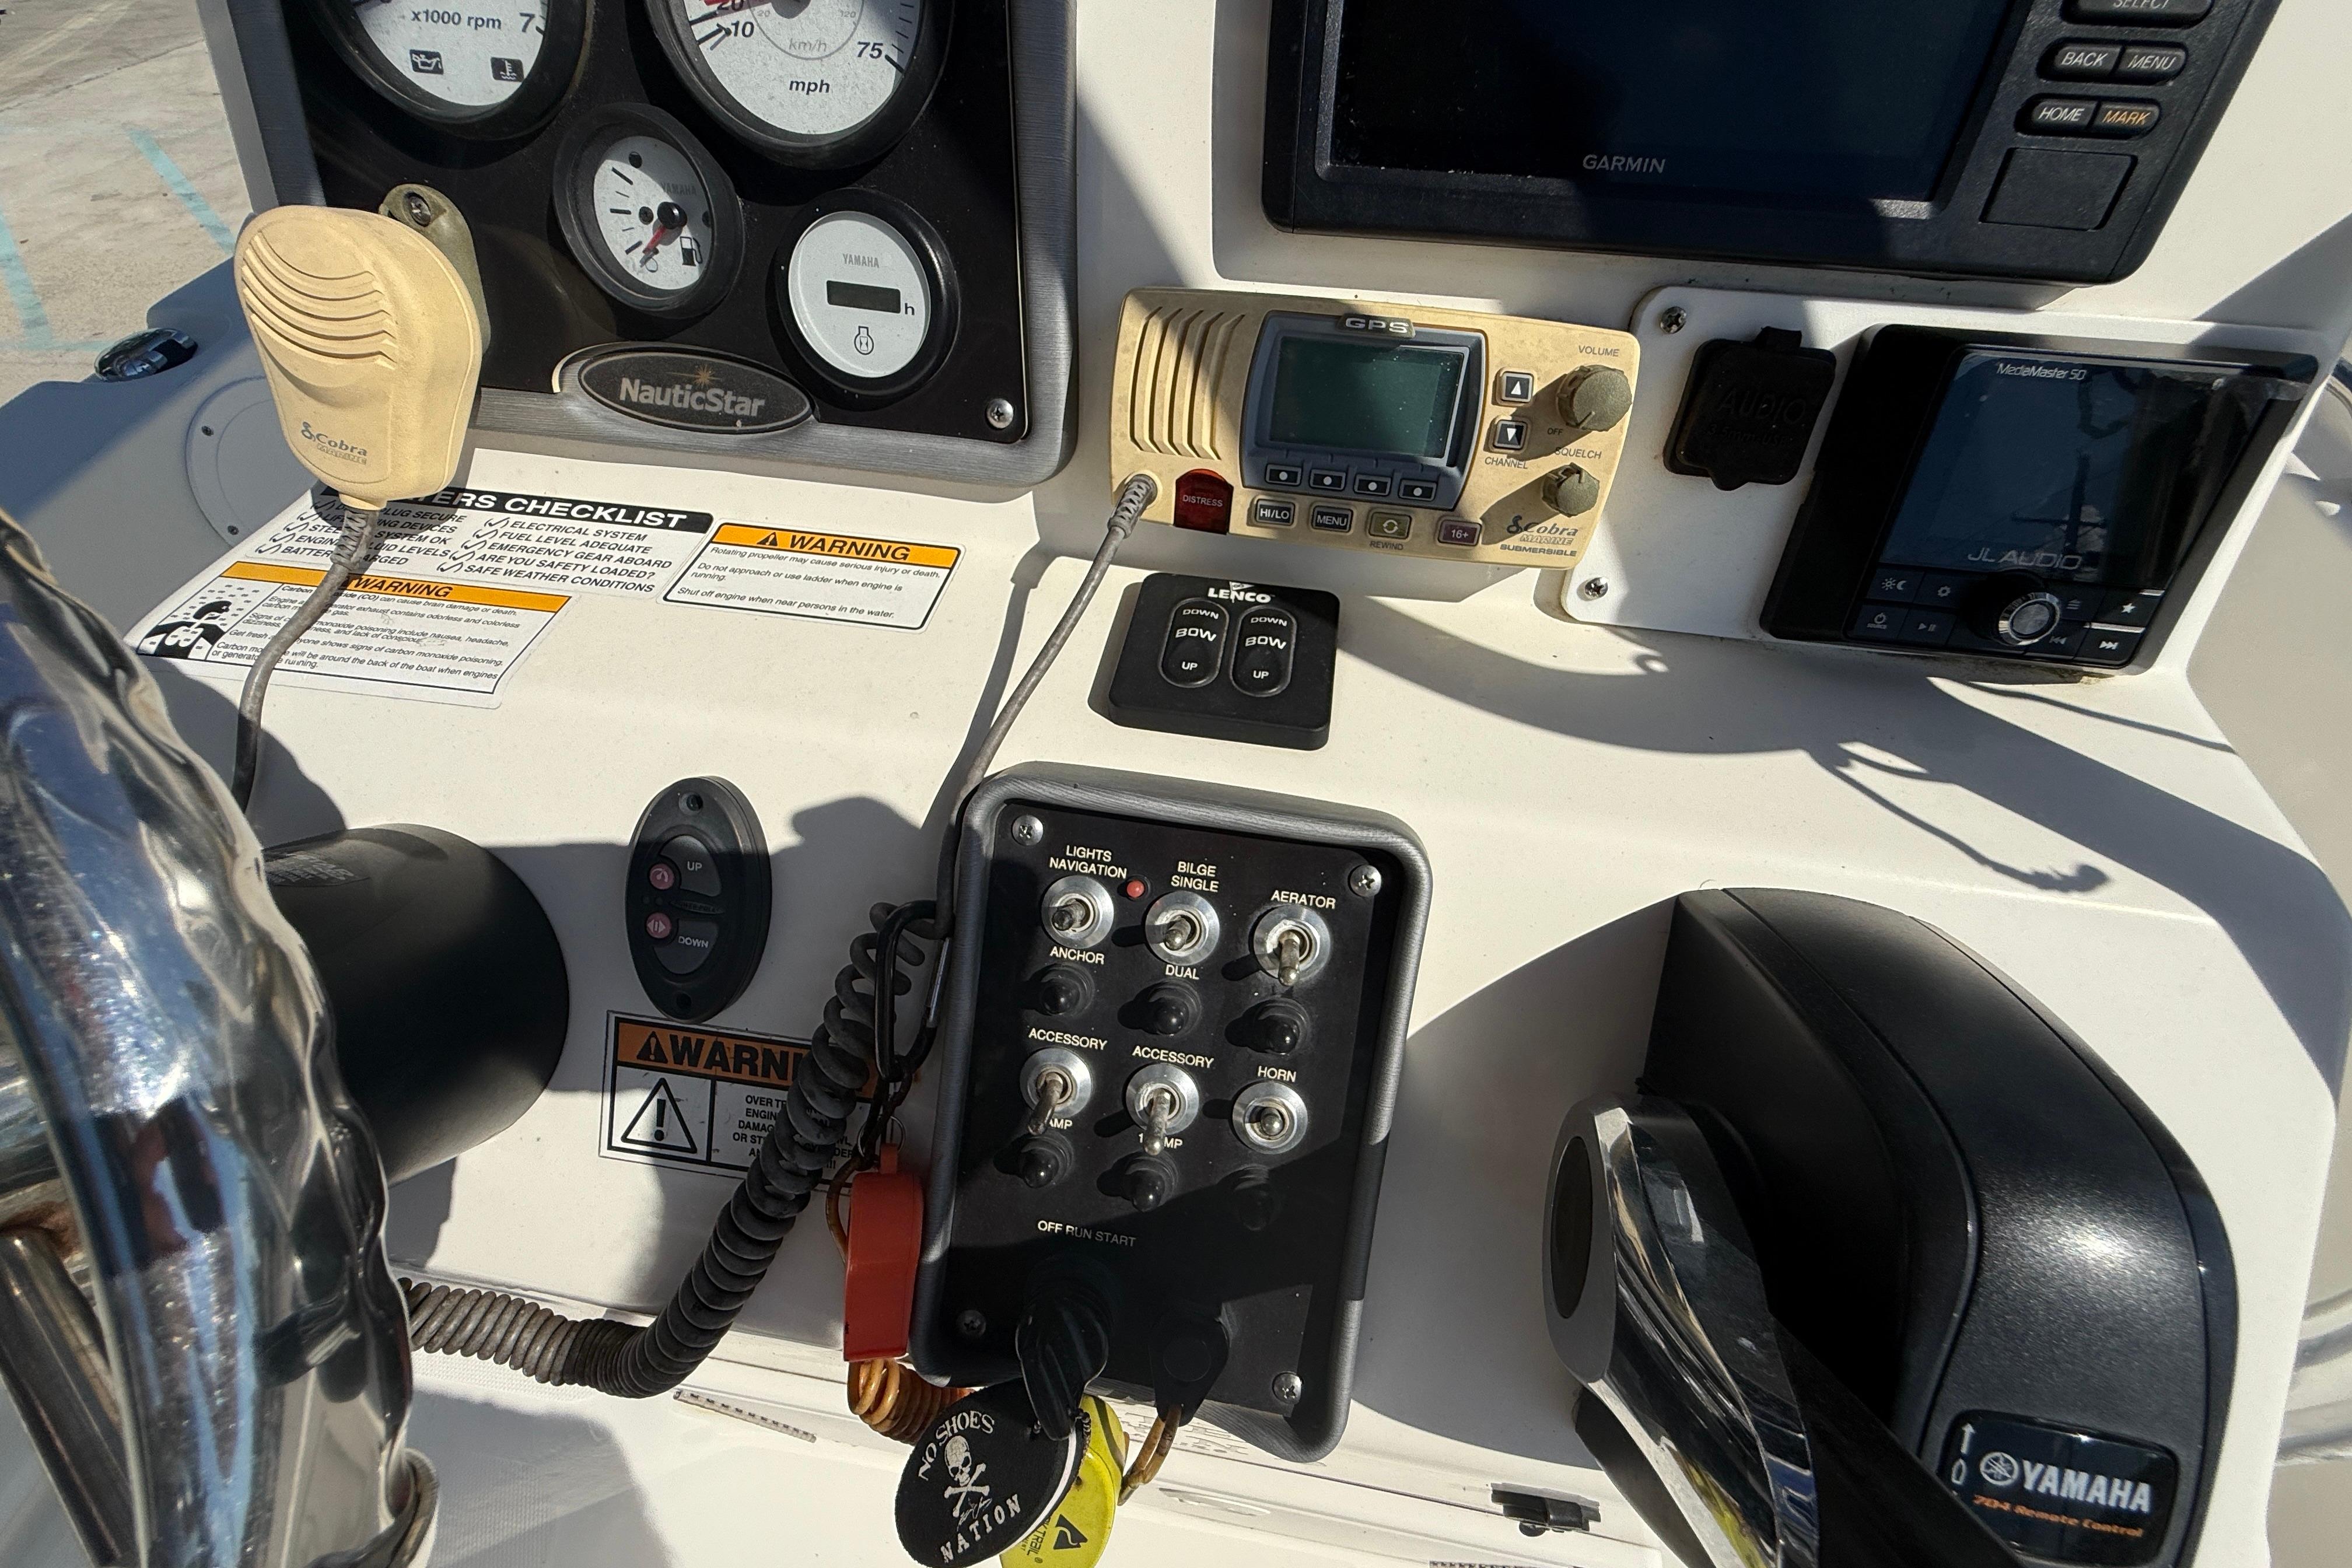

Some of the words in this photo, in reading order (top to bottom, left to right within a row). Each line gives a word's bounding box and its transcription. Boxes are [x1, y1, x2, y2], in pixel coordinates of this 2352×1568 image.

[411, 9, 461, 26] x1000
[467, 17, 502, 31] rpm
[758, 9, 771, 18] 20
[840, 10, 856, 18] 120
[519, 12, 536, 33] 7
[730, 21, 754, 38] 10
[789, 39, 827, 51] km/h
[856, 41, 884, 59] 75
[2061, 52, 2108, 66] BACK
[2127, 55, 2176, 70] MENU
[789, 79, 831, 96] mph
[2039, 107, 2085, 122] HOME
[2102, 110, 2151, 125] MARK
[1583, 154, 1665, 173] GARMIN
[662, 183, 697, 196] YAMAHA
[842, 254, 880, 268] YAMAHA
[905, 303, 915, 316] h
[1345, 317, 1409, 334] GPS
[1578, 345, 1620, 357] VOLUME
[1997, 363, 2068, 379] MediaMaster
[2069, 369, 2087, 380] 50
[620, 377, 765, 416] NauticStar
[1547, 428, 1563, 436] OFF
[316, 433, 367, 456] Cobra
[1555, 447, 1602, 460] SQUELCH
[1485, 456, 1528, 470] CHANNEL
[1182, 495, 1223, 508] DISTRESS
[412, 511, 467, 523] SECURE
[505, 498, 687, 527] CHECKLIST
[1259, 508, 1290, 520] HI/LO
[400, 522, 457, 533] DEVICES
[1317, 515, 1347, 527] MENU
[374, 530, 428, 542] SYSTEM
[429, 537, 452, 545] OK
[510, 521, 589, 535] ELECTRICAL
[593, 529, 648, 541] SYSTEM
[1451, 528, 1469, 539] 16+
[1522, 523, 1578, 536] Cobra
[295, 536, 340, 545] ENGIN
[399, 545, 451, 557] LEVELS
[499, 531, 535, 541] FUEL
[535, 535, 576, 546] LEVEL
[579, 540, 653, 554] ADEQUATE
[1369, 540, 1404, 551] REWIND
[1520, 534, 1574, 545] MARINE
[281, 546, 333, 557] BATTER
[488, 543, 573, 558] EMERGENCY
[575, 552, 614, 562] GEAR
[614, 556, 672, 569] ABOARD
[790, 535, 911, 561] WARNING
[1500, 544, 1577, 557] SUBMERSIBLE
[475, 554, 507, 563] ARE
[508, 556, 536, 566] YOU
[536, 560, 590, 572] SAFETY
[590, 565, 656, 580] LOADED?
[710, 547, 747, 558] Rotating
[748, 552, 789, 562] propeller
[789, 556, 809, 564] may
[839, 562, 873, 571] serious
[874, 566, 900, 575] injury
[1968, 548, 1997, 563] JL
[1998, 550, 2082, 570] AUDIO
[464, 565, 503, 575] SAFE
[502, 569, 570, 583] WEATHER
[570, 576, 655, 593] CONDITIONS
[691, 571, 726, 582] running.
[729, 566, 771, 577] approach
[803, 574, 833, 584] ladder
[834, 578, 859, 587] when
[862, 582, 892, 592] engine
[353, 578, 453, 598] WARNING
[1208, 587, 1272, 603] LENCO
[282, 586, 313, 594] Carbon
[446, 604, 479, 612] damage
[677, 587, 700, 596] Shut
[715, 592, 747, 601] engine
[748, 595, 774, 604] when
[797, 601, 836, 611] persons
[849, 607, 865, 615] the
[867, 609, 895, 618] water.
[268, 596, 296, 604] Engine
[390, 609, 425, 618] contains
[426, 614, 463, 622] odorless
[482, 619, 520, 628] colorless
[1182, 608, 1219, 620] DOWN
[249, 612, 274, 621] Signs
[355, 625, 397, 635] poisoning
[1251, 617, 1287, 626] DOWN
[1175, 628, 1217, 642] BOW
[1245, 636, 1287, 650] BOW
[247, 631, 267, 639] fresh
[321, 640, 348, 649] shows
[415, 652, 459, 660] monoxide
[216, 642, 247, 652] Carbon
[319, 653, 351, 663] around
[415, 664, 437, 672] boat
[463, 670, 498, 679] engines
[1181, 661, 1198, 671] UP
[1253, 670, 1269, 679] UP
[1066, 845, 1112, 862] LIGHTS
[687, 861, 702, 871] UP
[1049, 857, 1127, 880] NAVIGATION
[1177, 861, 1217, 877] BILGE
[1171, 875, 1219, 892] SINGLE
[1270, 890, 1336, 909] AERATOR
[678, 936, 709, 949] DOWN
[1050, 947, 1105, 964] ANCHOR
[1165, 965, 1199, 980] DUAL
[1029, 1028, 1108, 1050] ACCESSORY
[1132, 1046, 1214, 1069] ACCESSORY
[1258, 1066, 1296, 1082] HORN
[746, 1095, 773, 1108] OVER
[733, 1132, 748, 1143] OR
[1037, 1220, 1063, 1233] OFF
[1066, 1225, 1092, 1240] RUN
[1096, 1230, 1136, 1247] START
[918, 1442, 937, 1481] NO
[936, 1410, 995, 1447] SHOES
[2022, 1460, 2151, 1514] YAMAHA
[940, 1493, 1021, 1563] NATION
